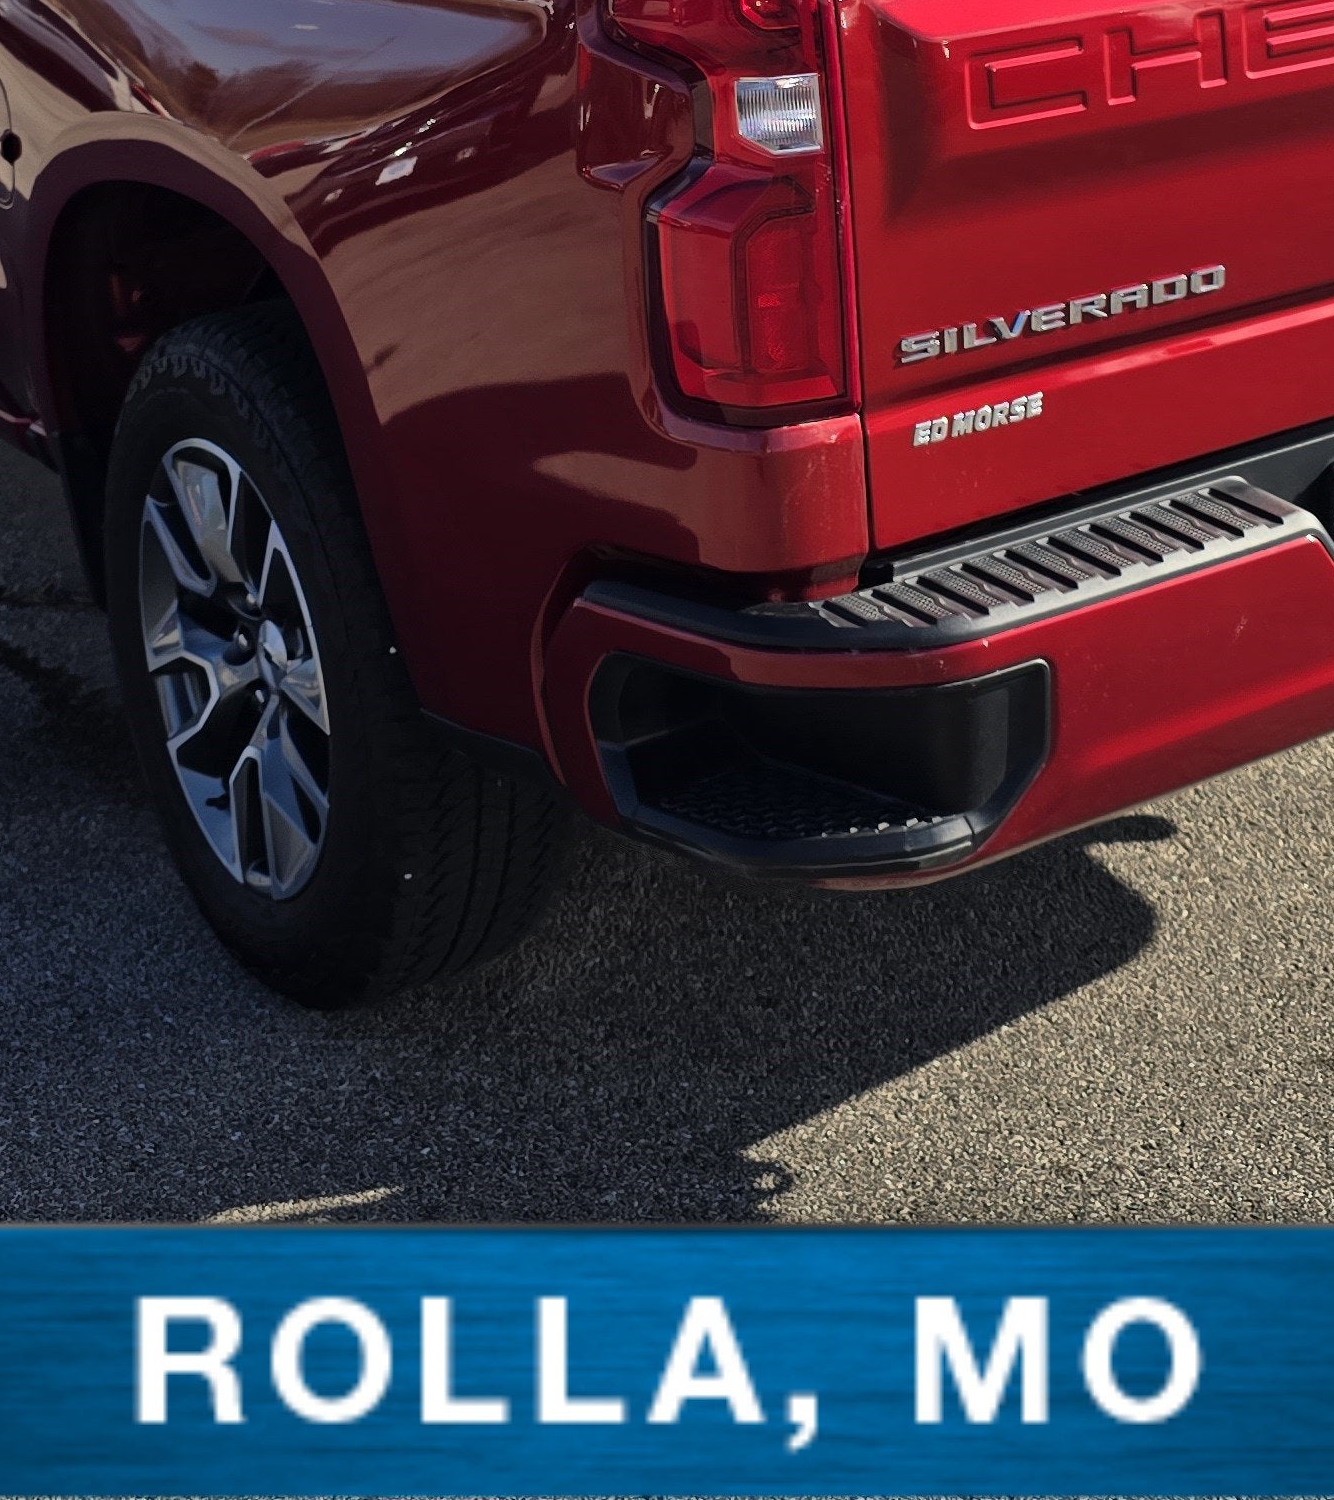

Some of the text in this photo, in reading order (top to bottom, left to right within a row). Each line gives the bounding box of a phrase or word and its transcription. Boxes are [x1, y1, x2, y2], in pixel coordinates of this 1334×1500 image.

[899, 264, 1226, 364] SILVERADO
[913, 391, 1044, 447] ED MORSE
